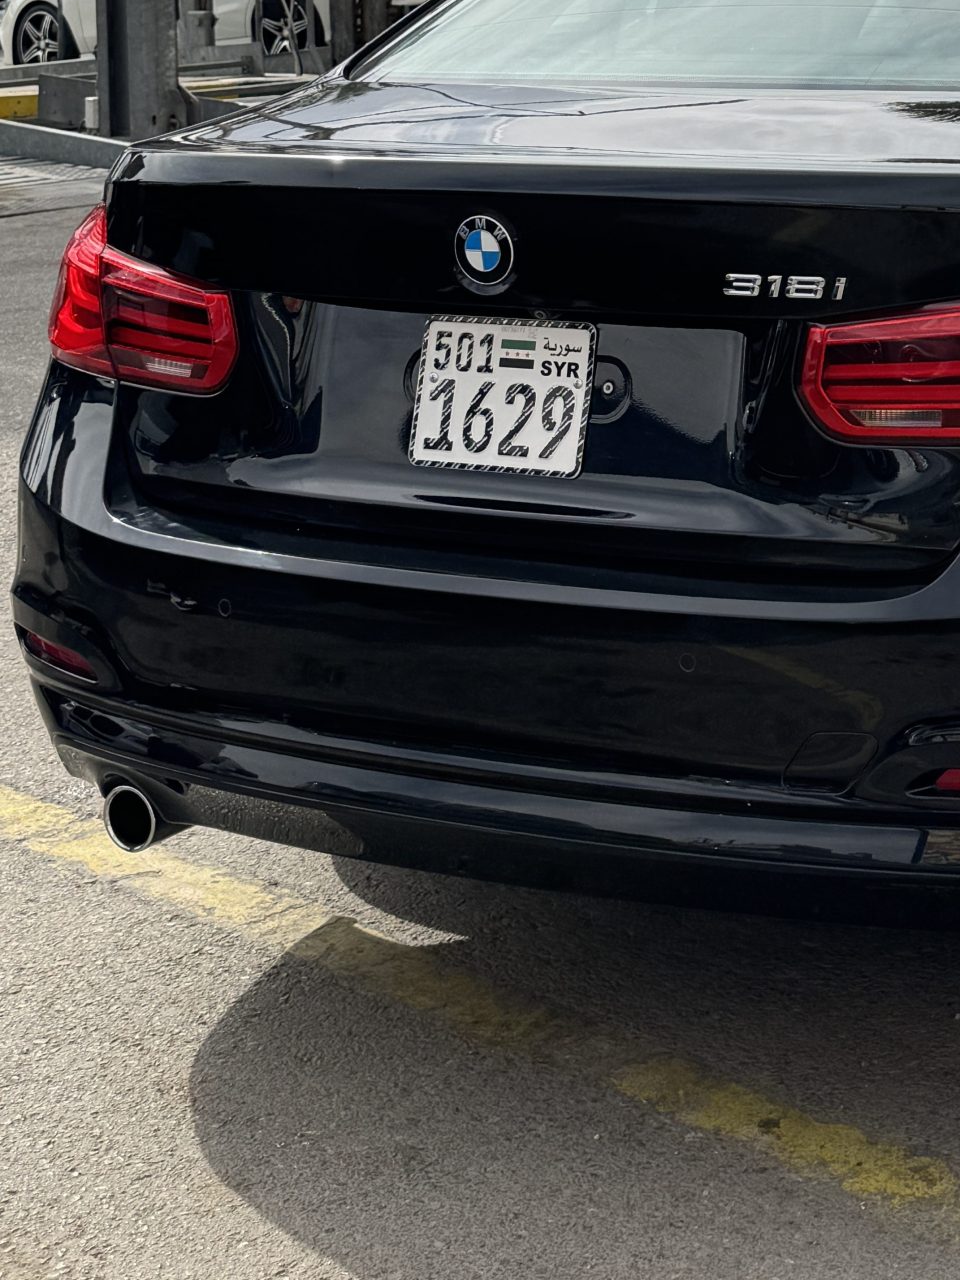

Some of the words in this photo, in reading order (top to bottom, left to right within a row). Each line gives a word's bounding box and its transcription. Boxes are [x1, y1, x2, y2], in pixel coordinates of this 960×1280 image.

[459, 218, 507, 241] BMW
[722, 273, 847, 300] 318i
[433, 330, 495, 374] 501
[543, 337, 583, 357] سورية
[540, 360, 580, 379] SYR
[423, 378, 576, 459] 1629
